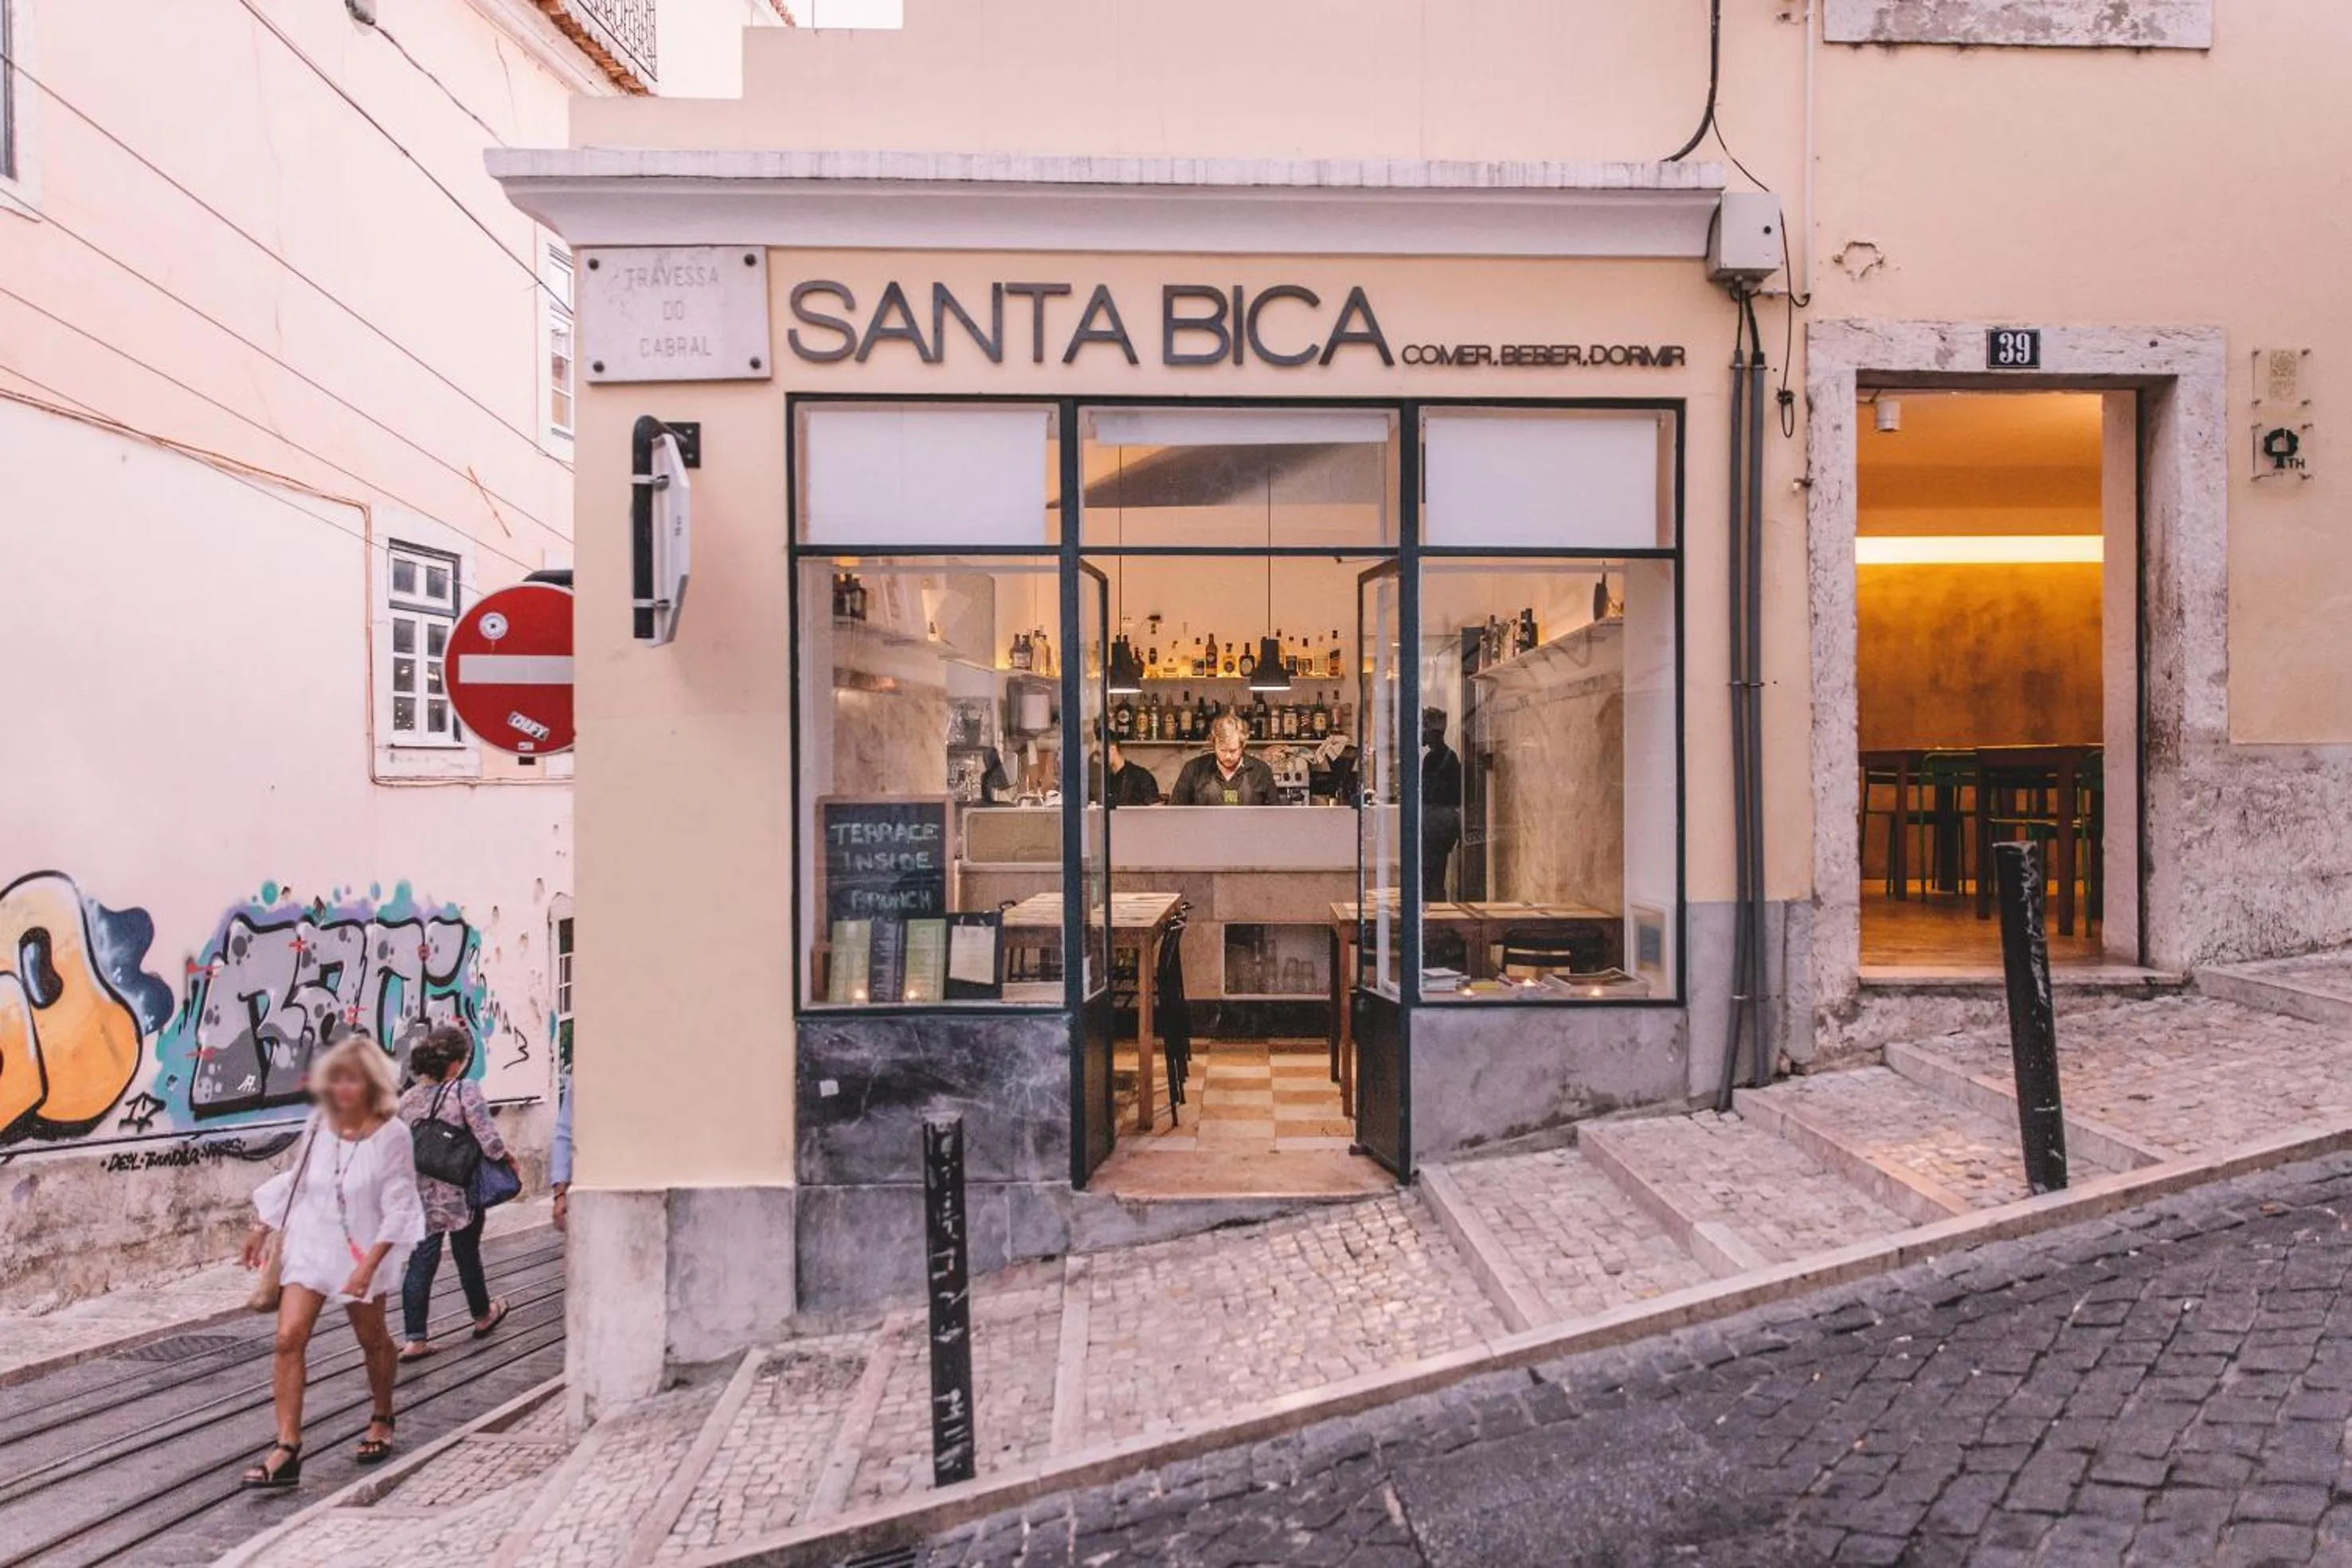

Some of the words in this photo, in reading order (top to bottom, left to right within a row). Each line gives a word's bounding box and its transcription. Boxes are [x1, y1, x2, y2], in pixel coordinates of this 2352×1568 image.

[624, 266, 718, 291] TRAVESSA
[662, 300, 685, 320] DO
[787, 280, 1139, 365] SANTA
[1162, 284, 1395, 367] BICA
[640, 335, 713, 358] CABRAL
[1998, 331, 2031, 365] 39
[829, 822, 940, 845] TERRACE
[844, 851, 934, 872] INSIDE
